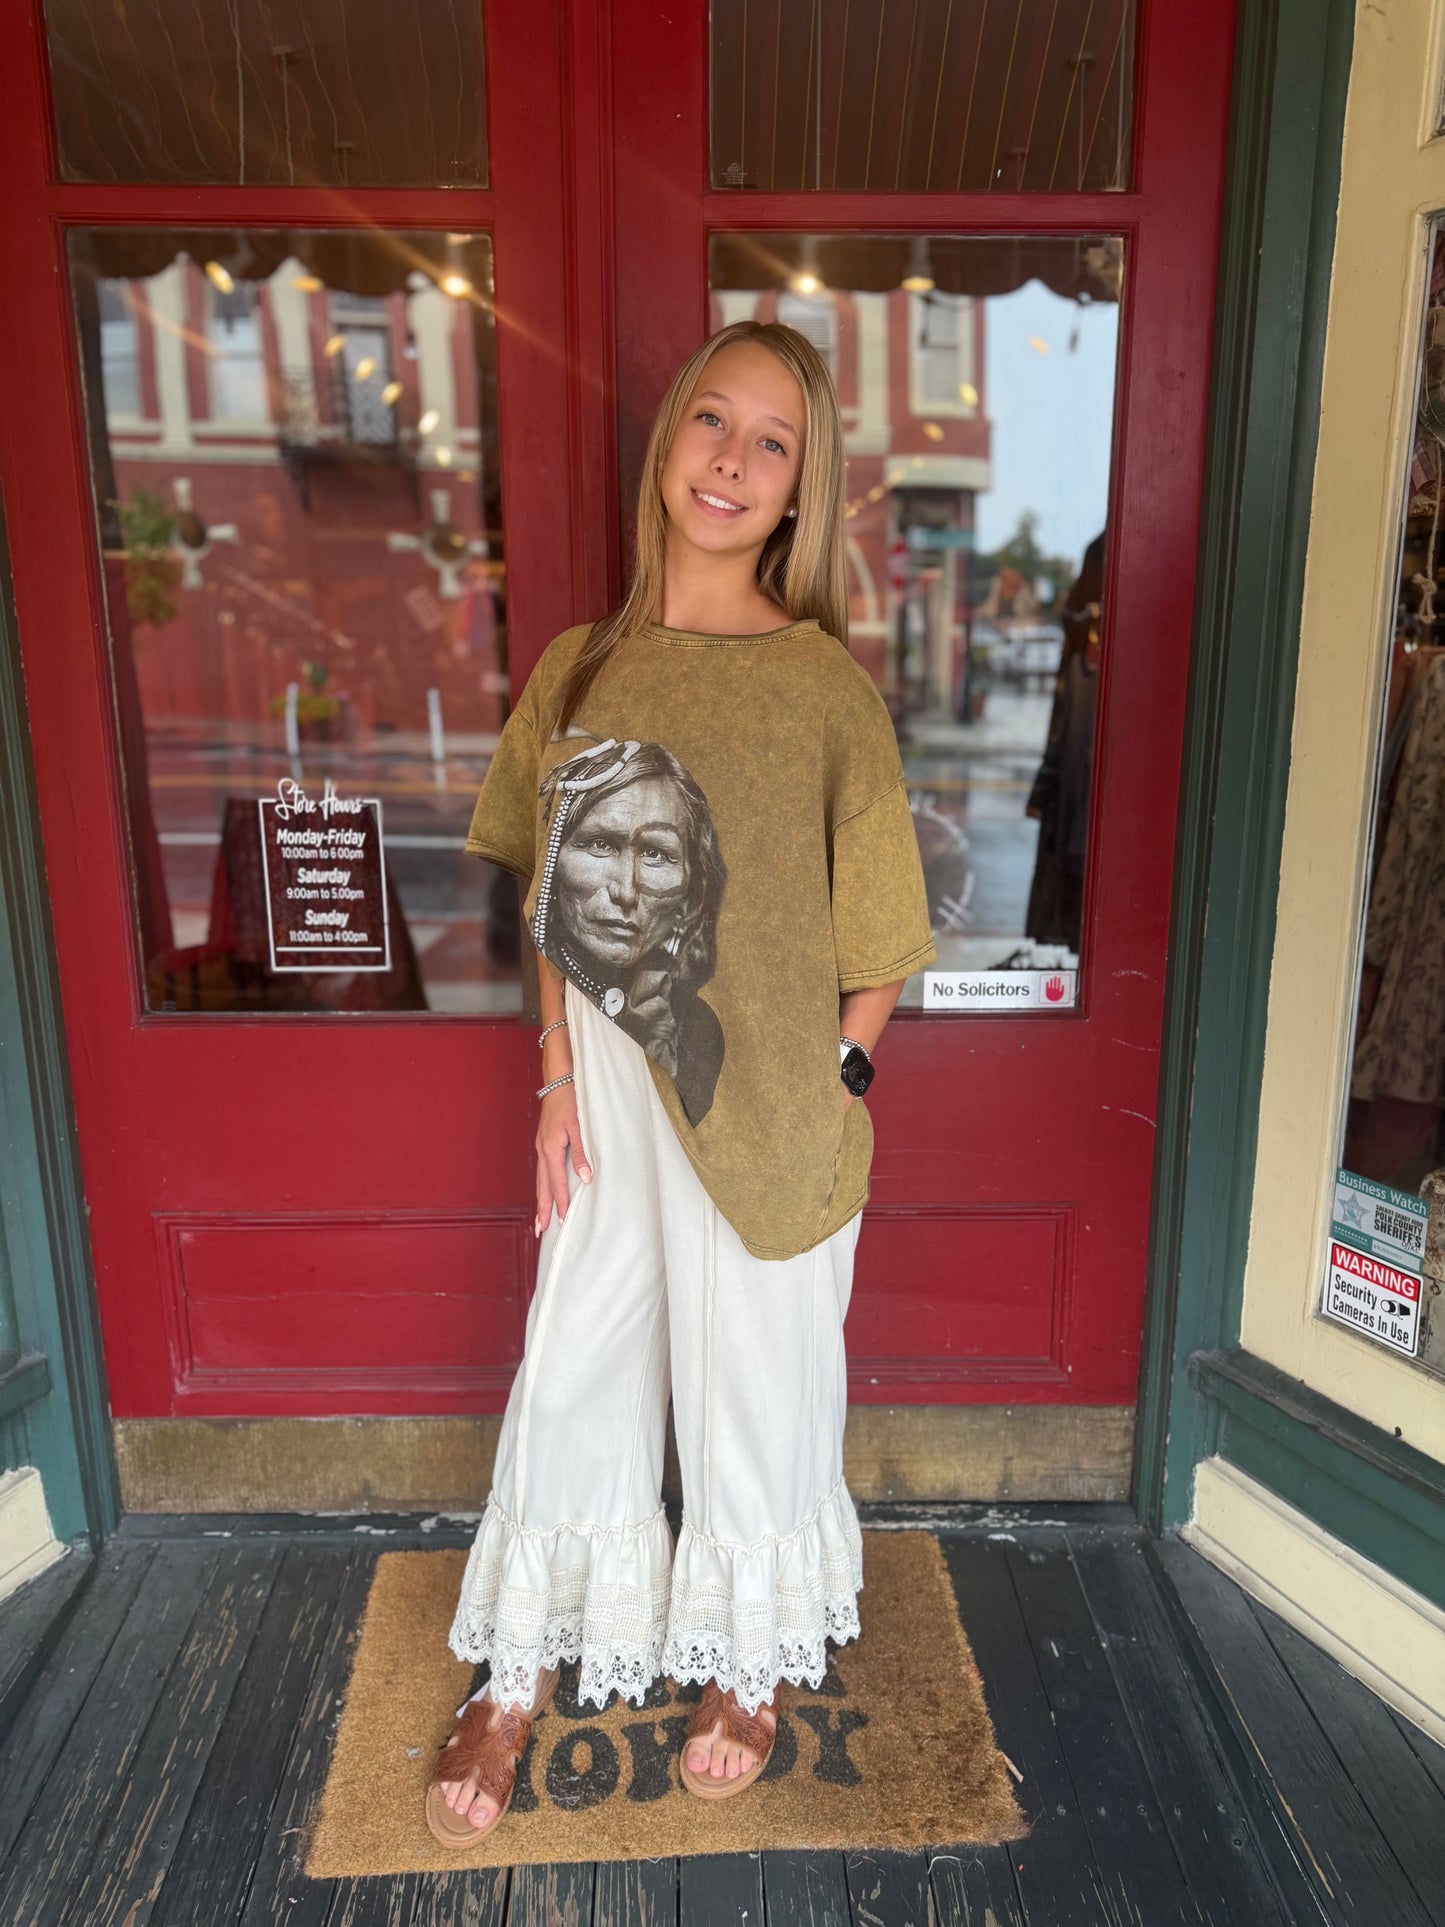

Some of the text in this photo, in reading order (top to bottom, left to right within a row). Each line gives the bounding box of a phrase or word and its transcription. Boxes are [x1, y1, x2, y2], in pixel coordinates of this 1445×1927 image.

[274, 777, 363, 821] Store Hours
[276, 828, 366, 848] Monday-Friday
[281, 847, 364, 860] 10:00am to 600pm
[297, 867, 351, 887] Saturday
[286, 887, 319, 899] 9:00am
[320, 888, 330, 899] to
[304, 908, 349, 928] Sunday
[289, 930, 322, 942] 11:00am
[323, 931, 333, 942] to
[933, 981, 1030, 997] No Solicitors
[1338, 1170, 1427, 1216] Business Watch
[1373, 1218, 1422, 1248] SHERIFF'S
[1375, 1210, 1422, 1236] POLK COUNTY
[1335, 1247, 1415, 1297] WARNING
[1334, 1273, 1378, 1310] Security
[1332, 1294, 1409, 1345] Cameras In Use
